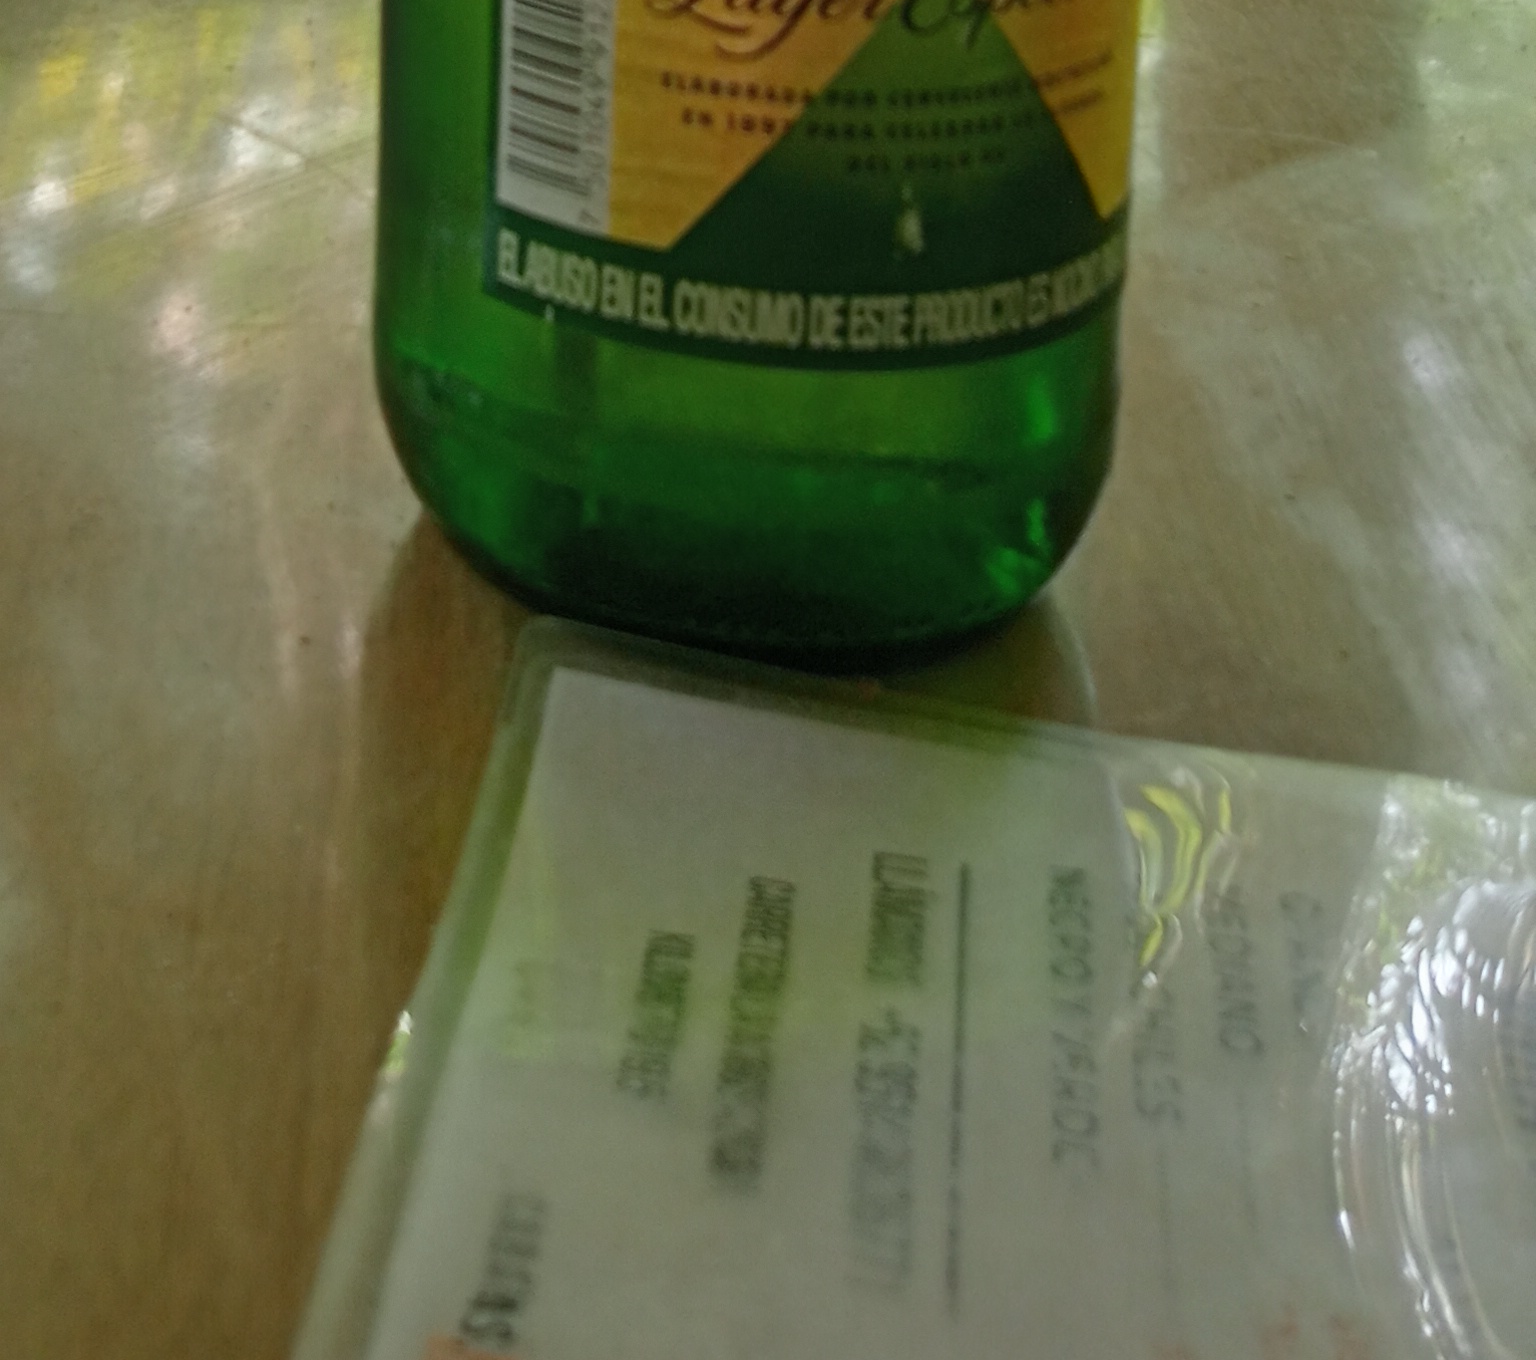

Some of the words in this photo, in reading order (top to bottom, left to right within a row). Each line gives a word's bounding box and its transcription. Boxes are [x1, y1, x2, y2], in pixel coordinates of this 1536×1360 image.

[497, 227, 529, 289] EL
[525, 240, 599, 313] ABUSO
[600, 263, 635, 322] EN
[639, 271, 670, 330] EL
[673, 278, 805, 351] CONSUMO
[809, 292, 847, 350] DE
[848, 292, 911, 351] ESTE
